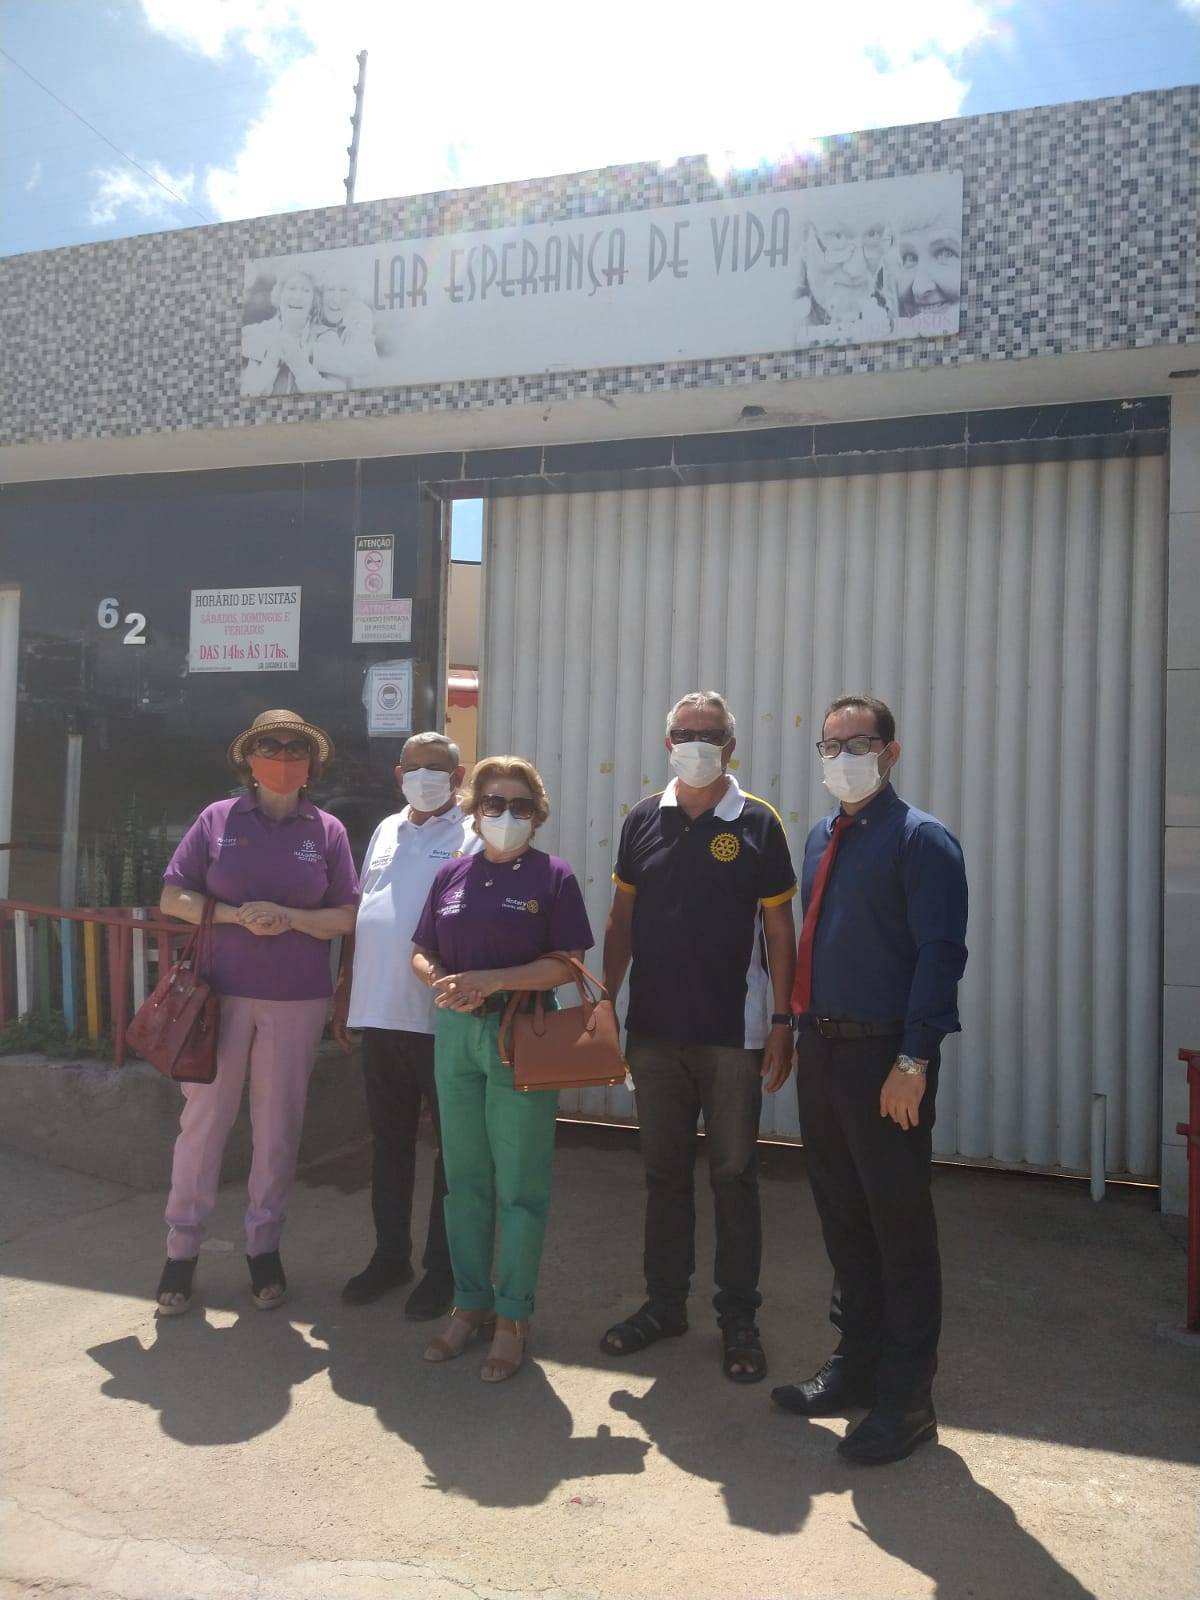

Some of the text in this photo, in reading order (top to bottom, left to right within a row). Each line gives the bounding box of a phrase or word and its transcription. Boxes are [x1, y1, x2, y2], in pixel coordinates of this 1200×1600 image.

[374, 207, 790, 311] LAR ESPERANÇA DE VIDA
[358, 537, 391, 549] ATENÇÃO
[195, 592, 297, 607] HORÁRIO DE VISITAS
[241, 611, 282, 623] DOMINGOS
[284, 612, 290, 622] E
[224, 624, 265, 636] FERIADOS
[200, 644, 219, 660] DAS
[223, 644, 245, 660] 14hs
[264, 643, 289, 659] 17hs.
[505, 897, 527, 907] Rotary
